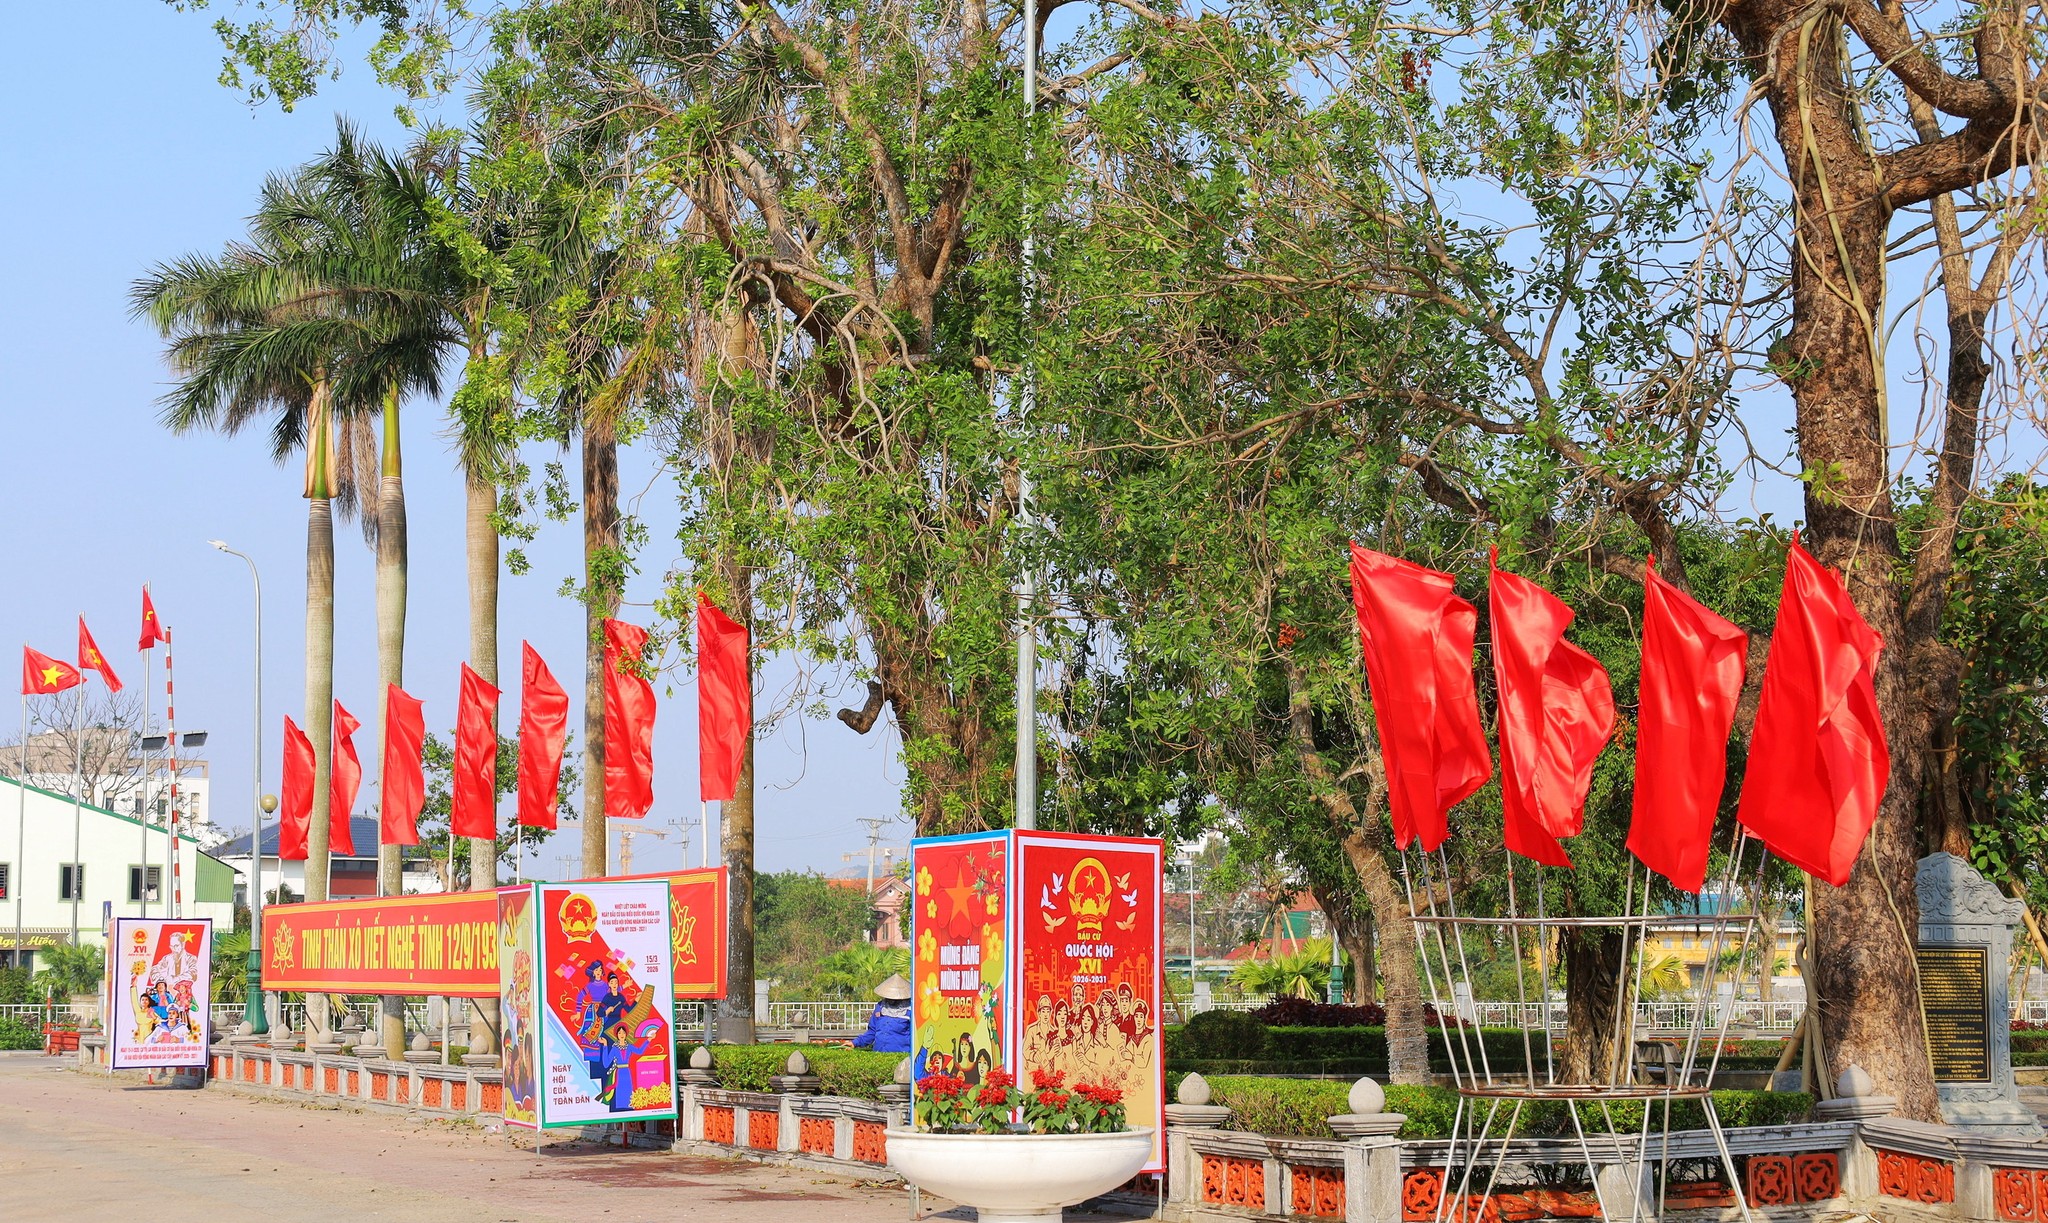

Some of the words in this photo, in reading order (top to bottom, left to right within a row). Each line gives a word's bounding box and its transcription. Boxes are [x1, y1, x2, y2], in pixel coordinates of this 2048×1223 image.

[134, 945, 147, 953] XVI
[302, 929, 321, 969] TINH
[323, 912, 347, 969] THẦN
[348, 918, 362, 969] XÔ
[364, 911, 385, 969] VIẾT
[387, 915, 415, 980] NGHỆ
[418, 914, 443, 970] TĨNH
[1065, 941, 1093, 957] QUỐC
[1095, 942, 1114, 961] HỘI
[1078, 958, 1102, 974] XVI
[1072, 975, 1107, 983] 2026-2031
[552, 1064, 571, 1073] NGÀY
[553, 1096, 573, 1105] TOÀN
[575, 1094, 590, 1104] DÂN
